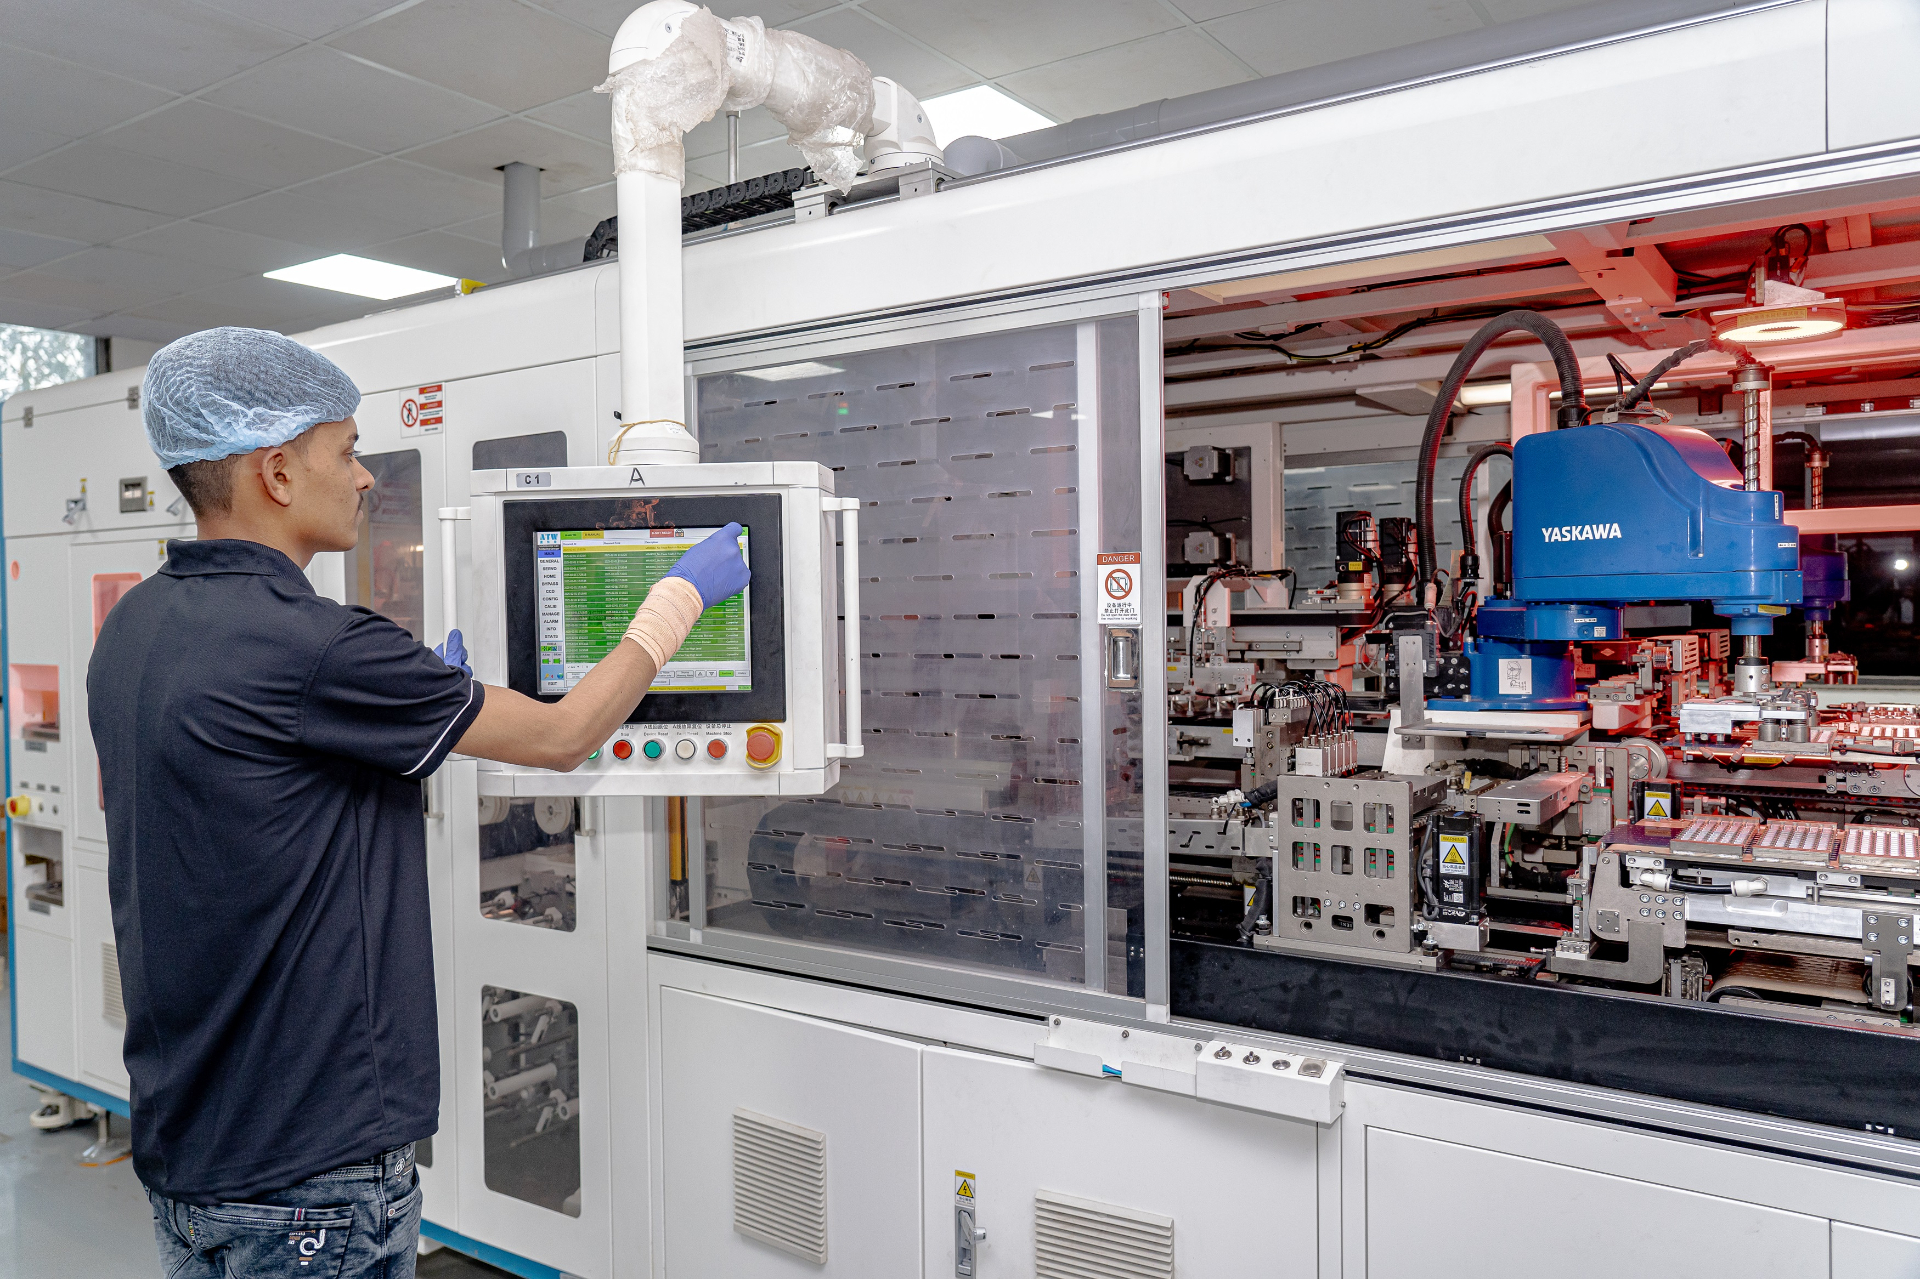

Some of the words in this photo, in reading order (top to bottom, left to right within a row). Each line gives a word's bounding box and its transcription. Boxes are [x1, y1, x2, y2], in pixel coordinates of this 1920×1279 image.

[629, 467, 646, 487] A
[539, 533, 559, 541] ATW
[1541, 522, 1622, 543] YASKAWA
